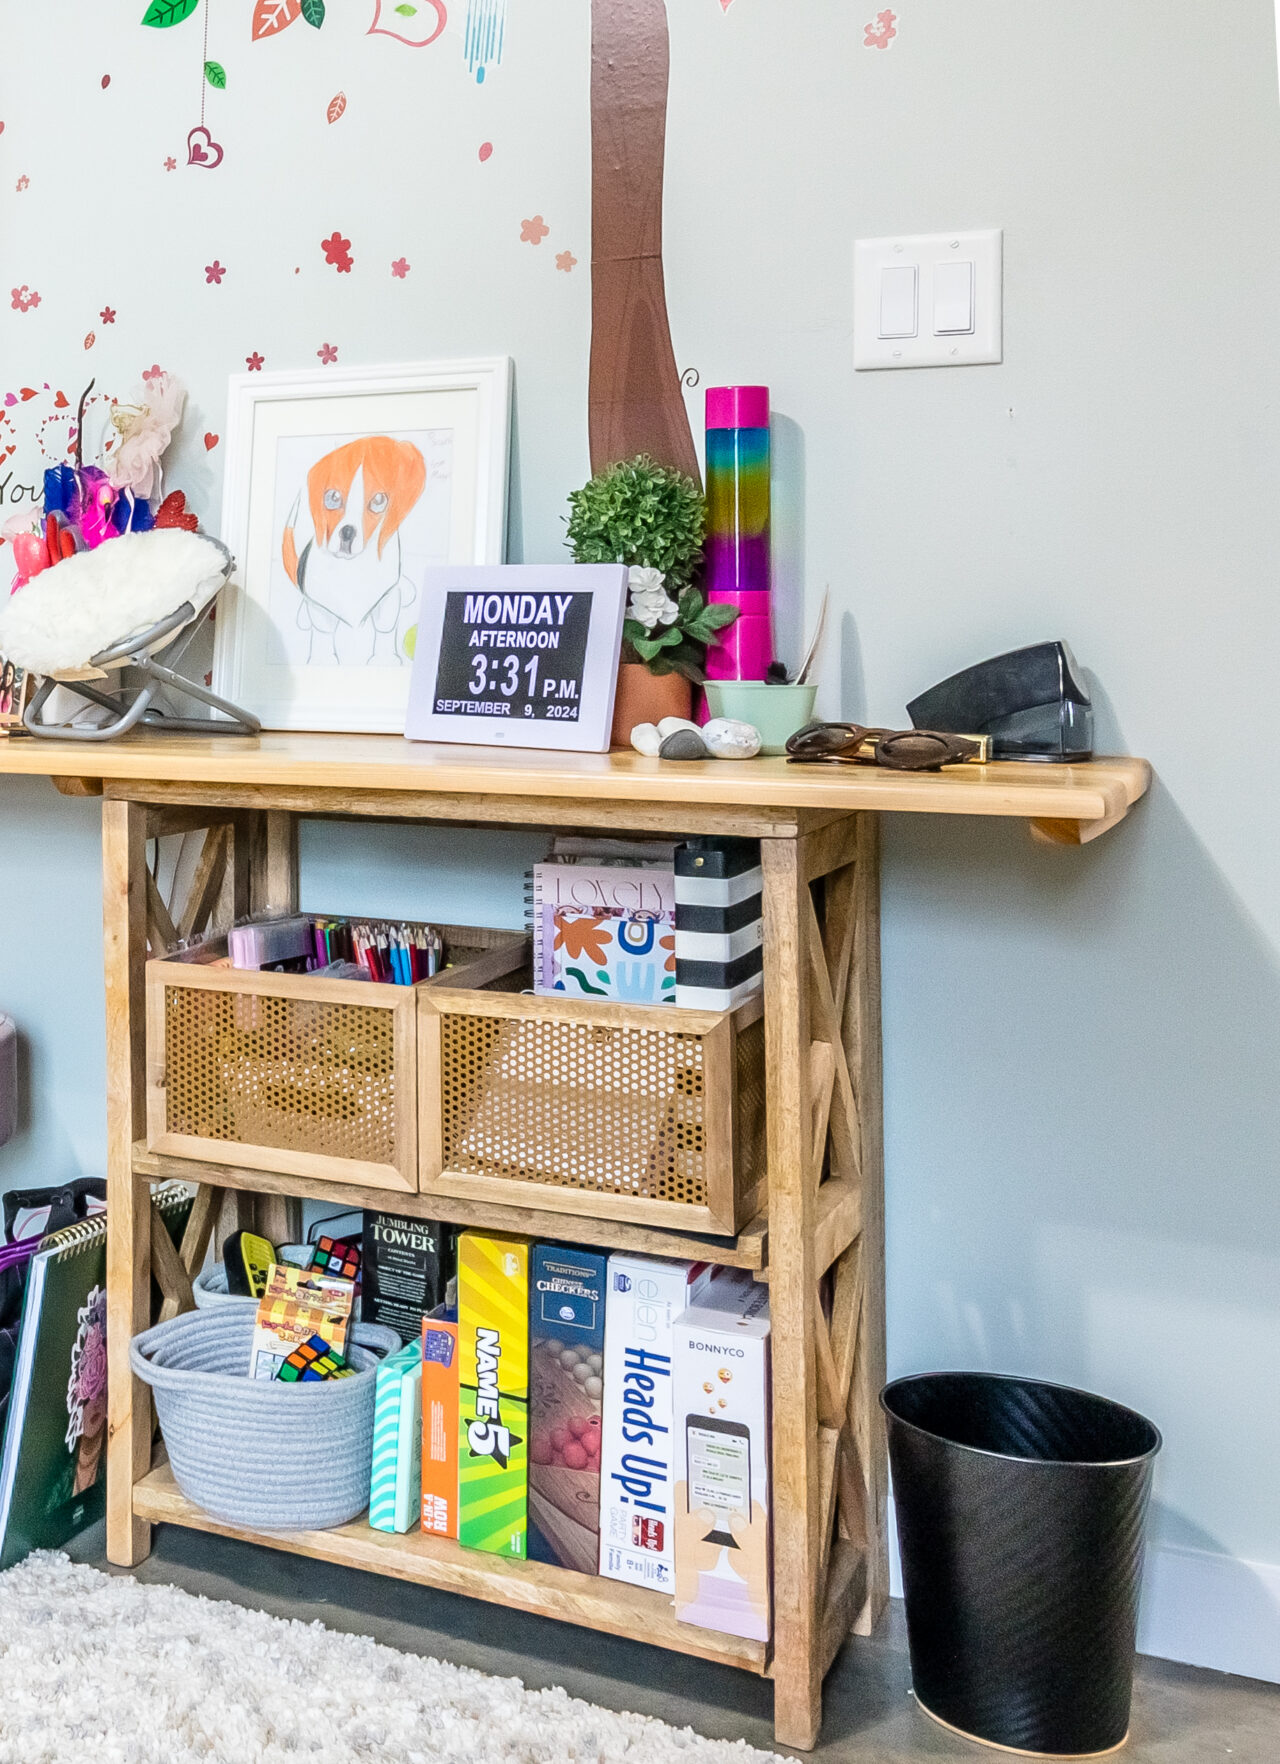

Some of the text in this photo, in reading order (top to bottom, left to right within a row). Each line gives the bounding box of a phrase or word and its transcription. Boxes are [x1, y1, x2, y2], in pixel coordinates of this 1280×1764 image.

[463, 595, 572, 625] MONDAY
[469, 630, 559, 648] AFTERNOON
[469, 654, 579, 699] 3:31 P.M.
[436, 699, 578, 718] SEPTEMBER 9, 2024
[370, 1223, 436, 1253] TOWER
[376, 1215, 429, 1235] JUMBLING
[545, 1264, 590, 1278] TRADITIONS
[536, 1280, 599, 1301] CHECKERS
[636, 1279, 665, 1342] ellen
[688, 1341, 745, 1358] BONNYCO
[468, 1326, 510, 1456] NAME 5
[611, 1347, 672, 1514] Heads Up!
[423, 1493, 434, 1530] 4-IN-A
[434, 1495, 448, 1532] ROW
